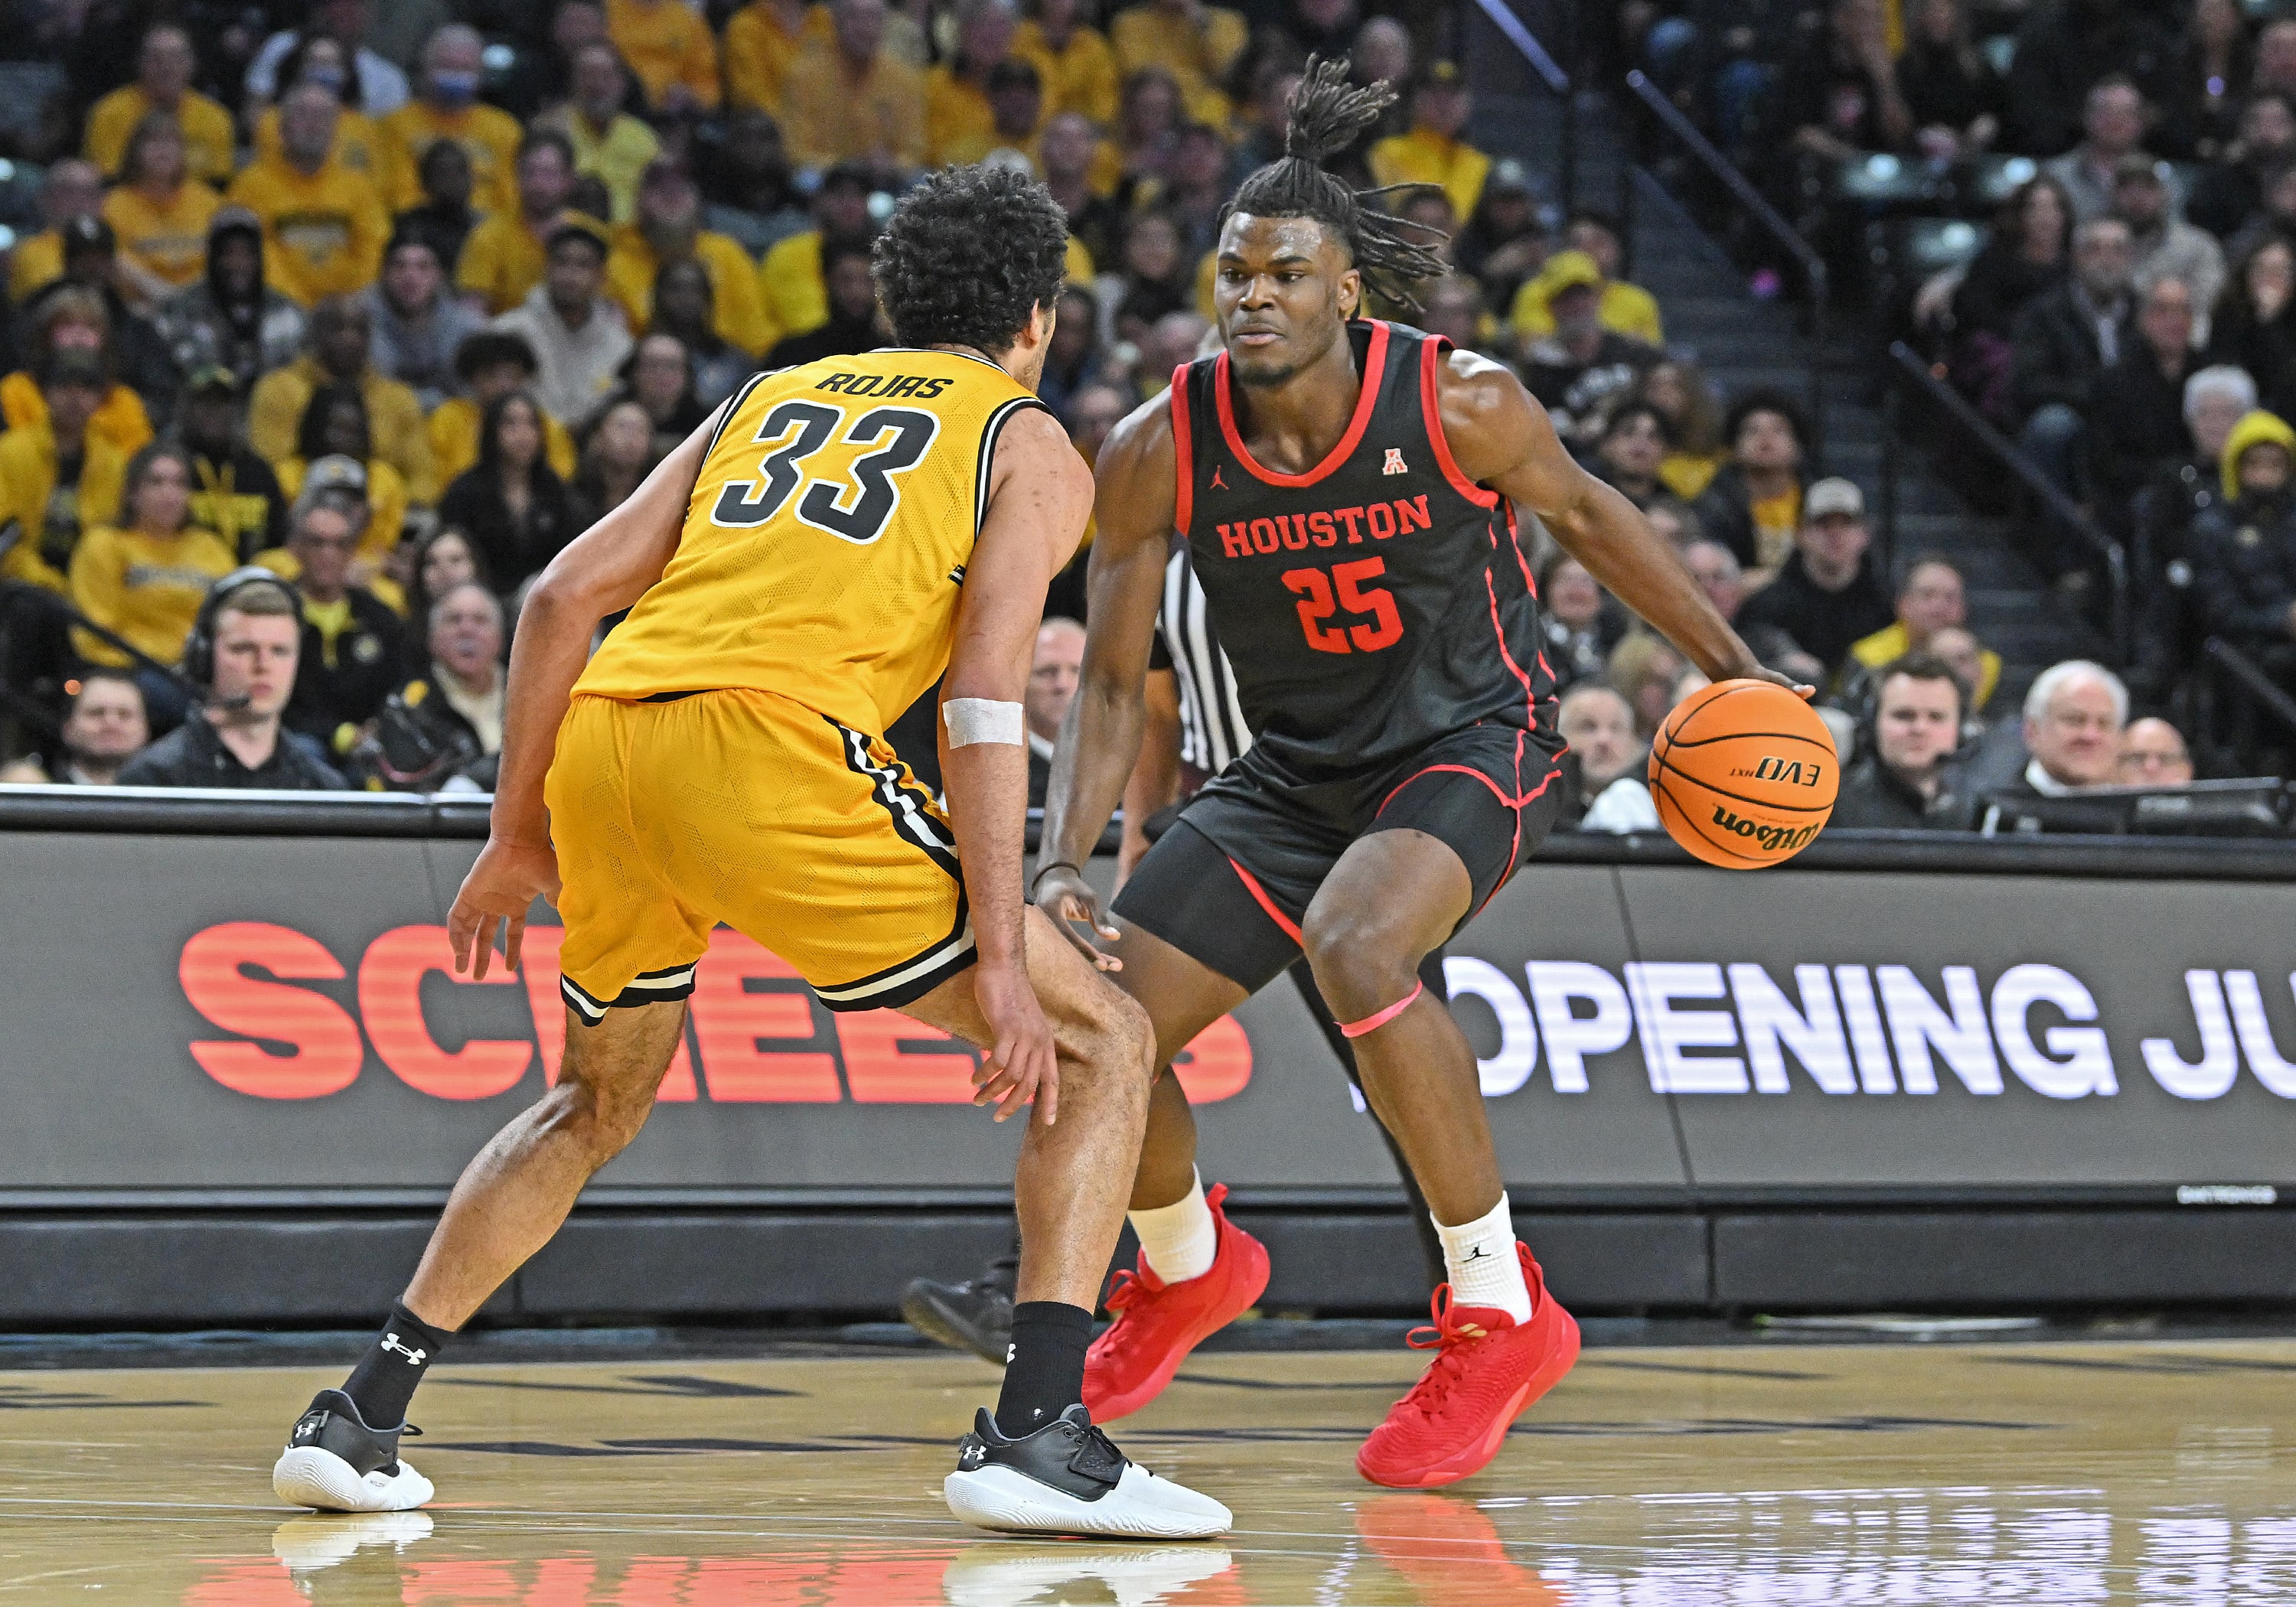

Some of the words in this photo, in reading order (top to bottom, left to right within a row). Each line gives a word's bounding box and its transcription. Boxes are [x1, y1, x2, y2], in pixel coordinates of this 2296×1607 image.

[814, 373, 954, 399] ROJAS
[709, 398, 941, 545] 33
[1382, 448, 1408, 475] A
[1216, 494, 1432, 558] HOUSTON
[1280, 556, 1404, 654] 25
[1755, 755, 1821, 787] EVO
[1712, 806, 1821, 851] Wilson
[178, 921, 1254, 1103] SCEE
[1442, 956, 2119, 1100] OPENING
